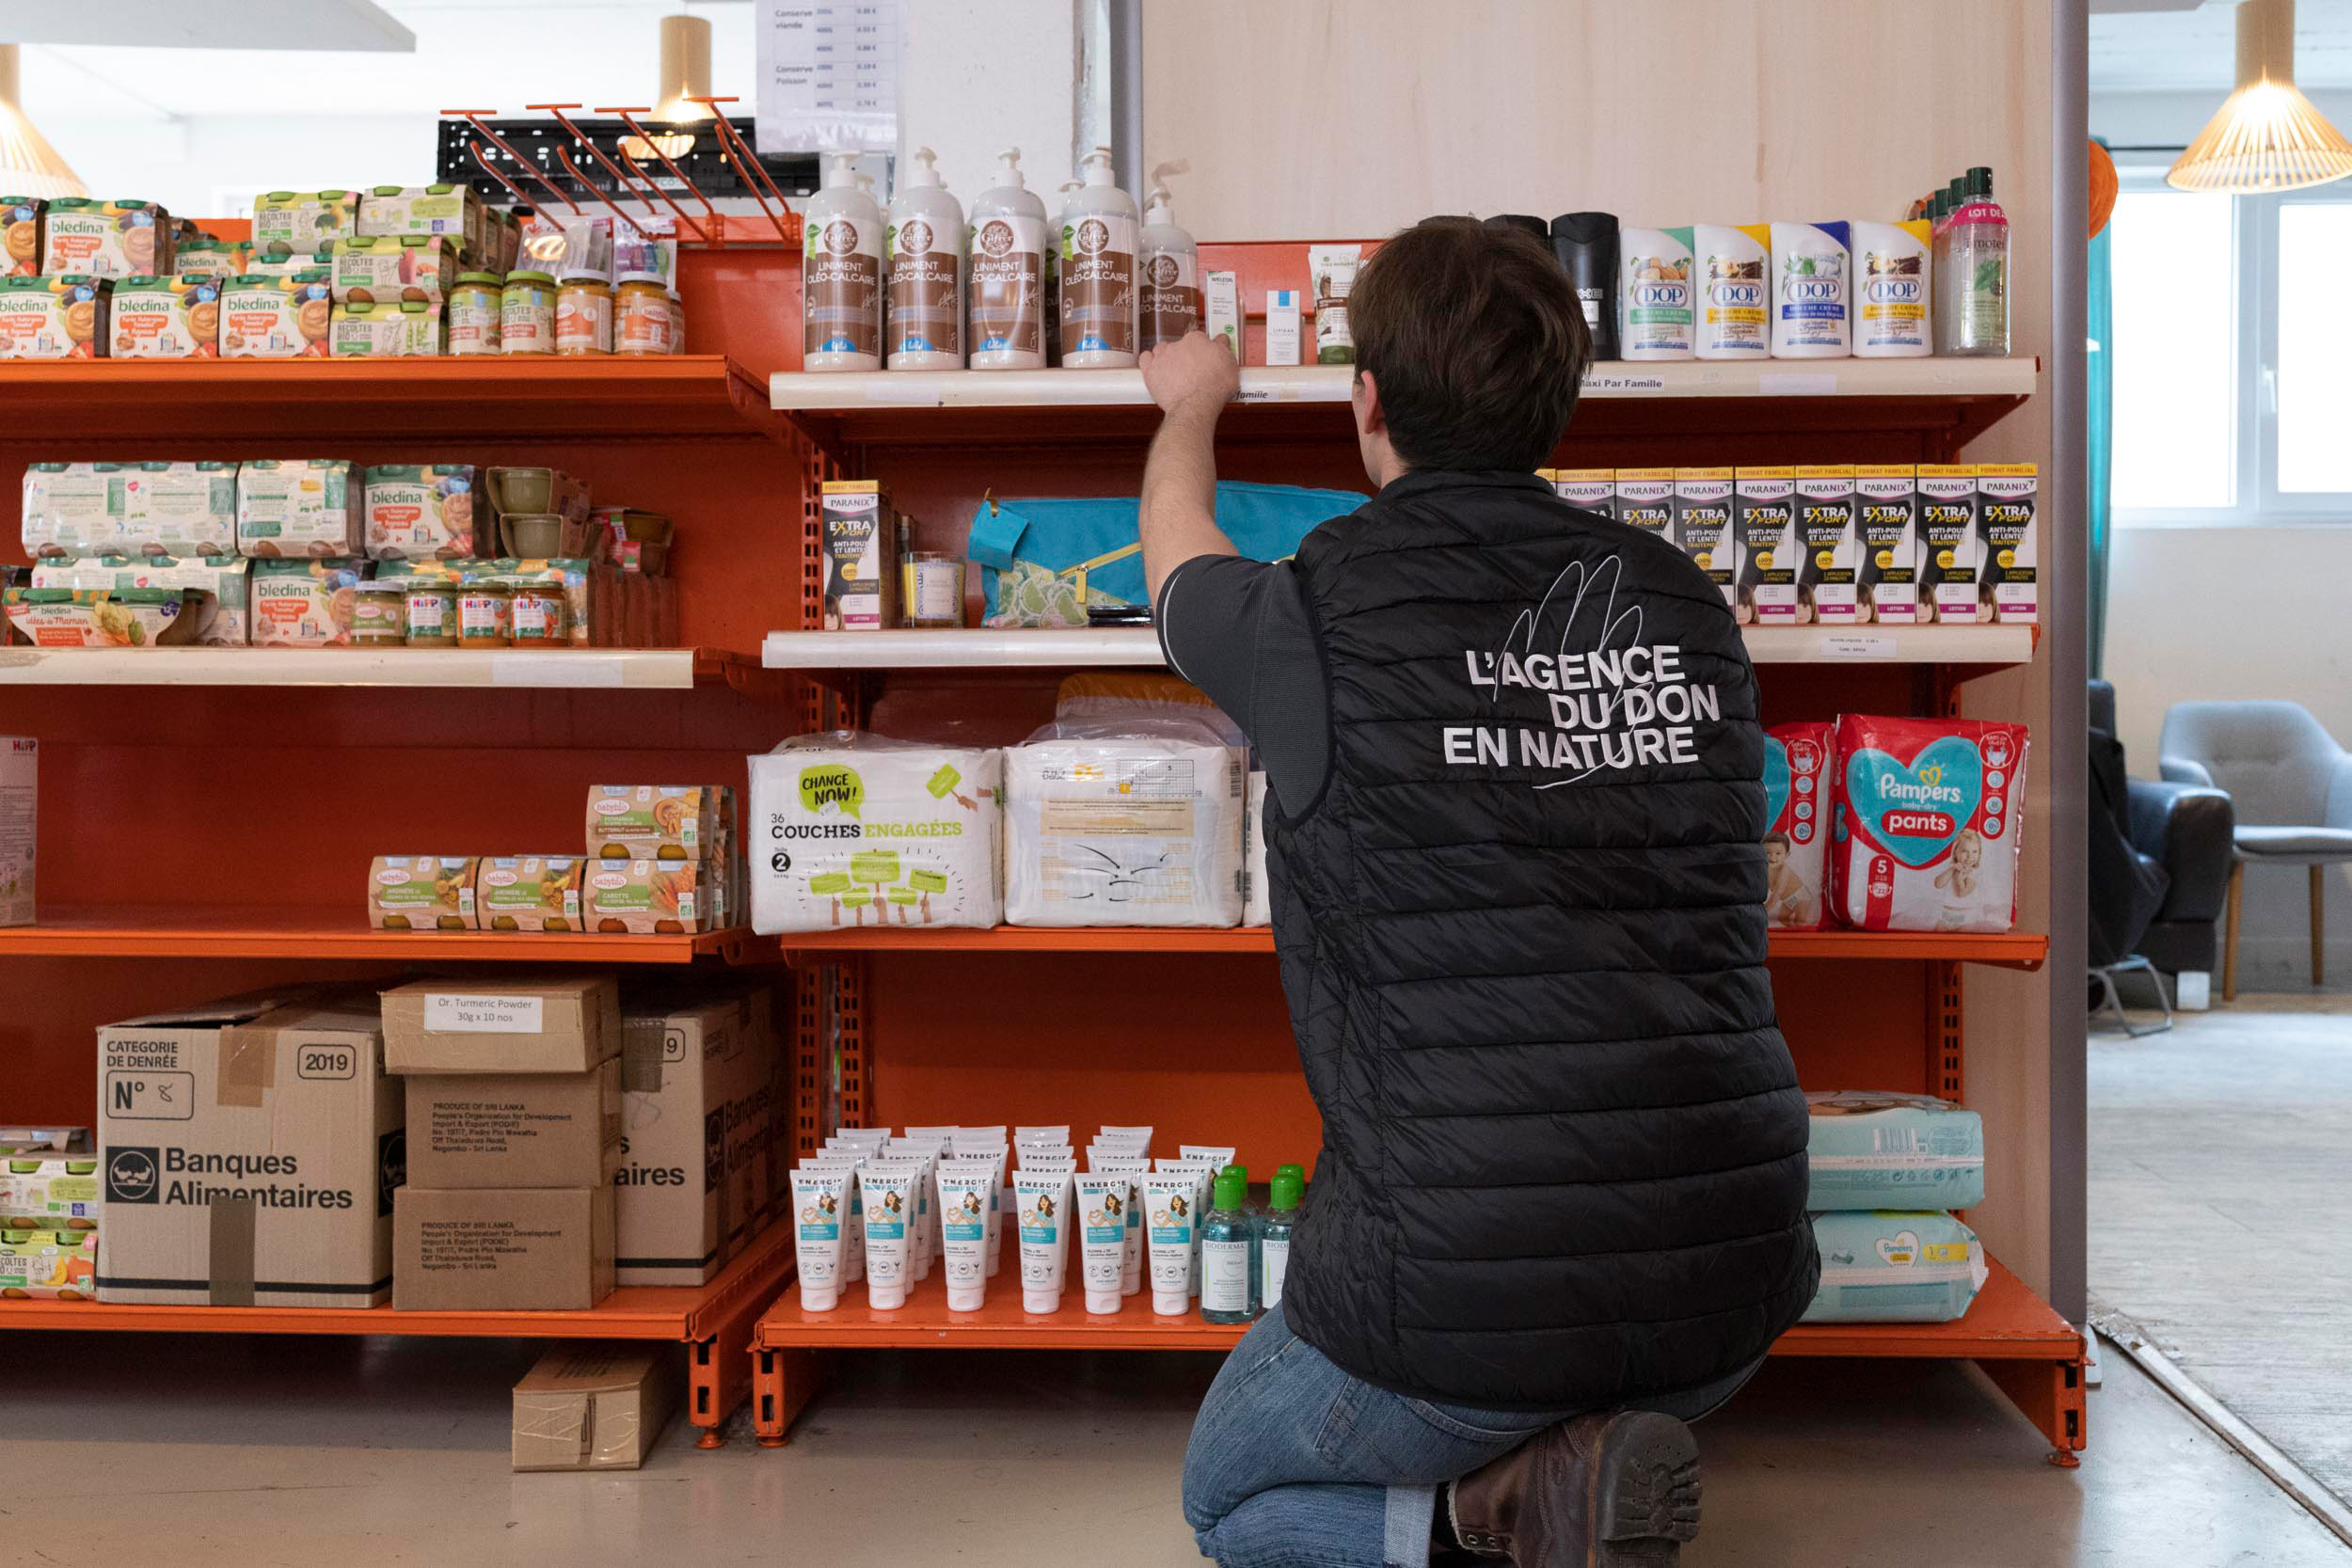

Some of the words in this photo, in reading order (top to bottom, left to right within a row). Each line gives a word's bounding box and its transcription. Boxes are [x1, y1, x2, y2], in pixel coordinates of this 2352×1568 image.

[775, 9, 813, 18] Conserve
[775, 65, 814, 73] Conserve
[776, 77, 807, 86] Poisson
[1968, 208, 1986, 218] LOT
[818, 261, 863, 271] LINIMENT
[896, 261, 939, 271] LINIMENT
[975, 261, 1019, 272] LINIMENT
[971, 272, 1037, 283] ÉO-CALCAIRE
[1645, 287, 1682, 302] DOP
[1723, 287, 1759, 302] DOP
[1797, 282, 1836, 297] DOP
[1878, 282, 1917, 297] DOP
[1142, 293, 1184, 303] LINIMENT
[1604, 379, 1621, 388] Par
[1625, 379, 1662, 388] Famille
[1235, 390, 1268, 400] famille
[1565, 487, 1606, 497] PARANIX
[1624, 486, 1665, 496] PARANIX
[1683, 486, 1724, 495] PARANIX
[1745, 485, 1787, 494] PARANIX
[1804, 484, 1847, 493] PARANIX
[1865, 483, 1907, 492] PARANIX
[1986, 483, 2028, 491] PARANIX
[831, 499, 870, 507] PARANIX
[1623, 509, 1667, 522] EXTRA
[1682, 509, 1726, 522] EXTRA
[1743, 508, 1788, 521] EXTRA
[1804, 507, 1848, 520] EXTRA
[1863, 506, 1908, 519] EXTRA
[1925, 506, 1969, 519] EXTRA
[1985, 505, 2029, 518] EXTRA
[830, 520, 871, 533] EXTRA
[1466, 644, 1686, 690] L'AGENCE
[1548, 692, 1612, 730] DU
[1623, 684, 1721, 727] DON
[1443, 727, 1508, 768] EN
[1519, 725, 1699, 769] NATURE
[803, 773, 849, 790] CHANGE
[1881, 772, 1962, 804] Pampers
[1901, 801, 1938, 811] baby-dry
[771, 813, 785, 824] 36
[1888, 814, 1947, 833] pants
[771, 824, 861, 839] COUCHES
[865, 818, 962, 838] ENGAGÉES
[775, 856, 787, 871] 2
[1877, 860, 1887, 874] 5
[437, 997, 452, 1007] Or.
[454, 998, 496, 1008] Turmeric
[498, 999, 532, 1009] Powder
[457, 1012, 474, 1022] 30g
[485, 1013, 495, 1022] 10
[106, 1040, 178, 1053] CATEGORIE
[107, 1055, 124, 1068] DE
[127, 1053, 178, 1068] DENRÉE
[305, 1053, 348, 1071] 2019
[115, 1081, 145, 1110] N°
[433, 1102, 469, 1111] PRODUCE
[472, 1102, 483, 1111] OF
[524, 1114, 572, 1122] Development
[166, 1147, 298, 1180] Banques
[1019, 1180, 1062, 1189] ENERGIE
[1083, 1180, 1127, 1188] ENERGIE
[1149, 1180, 1194, 1188] ENERGIE
[0, 1257, 27, 1266] COLTES
